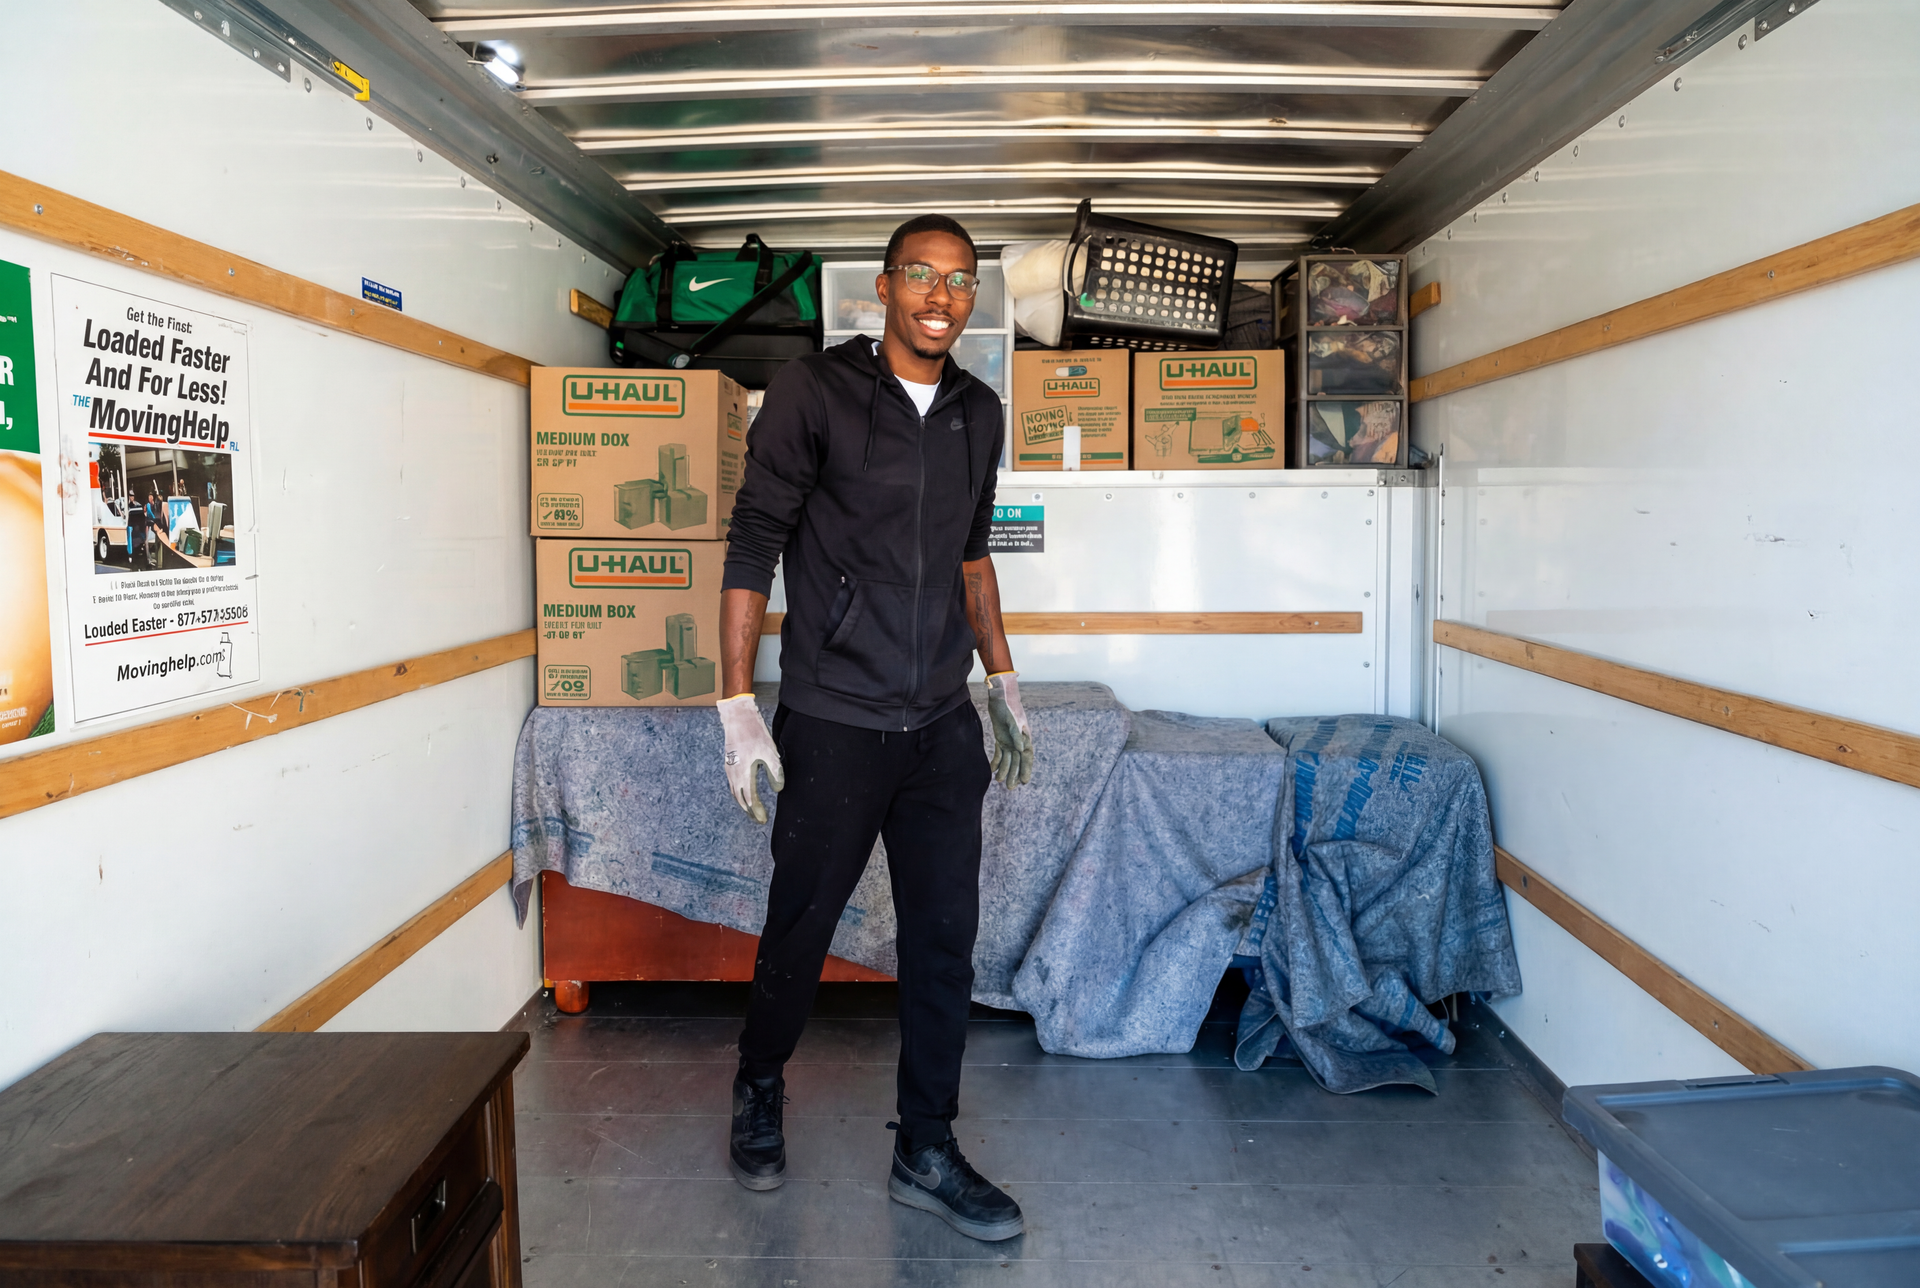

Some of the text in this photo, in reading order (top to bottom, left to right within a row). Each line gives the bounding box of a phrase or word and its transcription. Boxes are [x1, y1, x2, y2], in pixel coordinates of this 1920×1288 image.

[127, 307, 144, 323] Get
[147, 312, 164, 327] the
[84, 318, 230, 374] Loaded Faster
[1166, 362, 1251, 378] U-HAUL
[85, 357, 228, 405] And For Less!
[1047, 381, 1097, 390] U-HAUL
[72, 394, 91, 408] THE
[570, 381, 677, 402] U-HAUL
[89, 397, 230, 449] MovingHelp
[536, 431, 630, 447] MEDIUM DOX
[1007, 508, 1022, 518] ON
[577, 554, 684, 574] U-HAUL
[543, 603, 636, 619] MEDIUM BOX
[84, 618, 128, 639] Louded
[132, 616, 167, 633] Easter
[116, 651, 222, 682] Movinghelp.com
